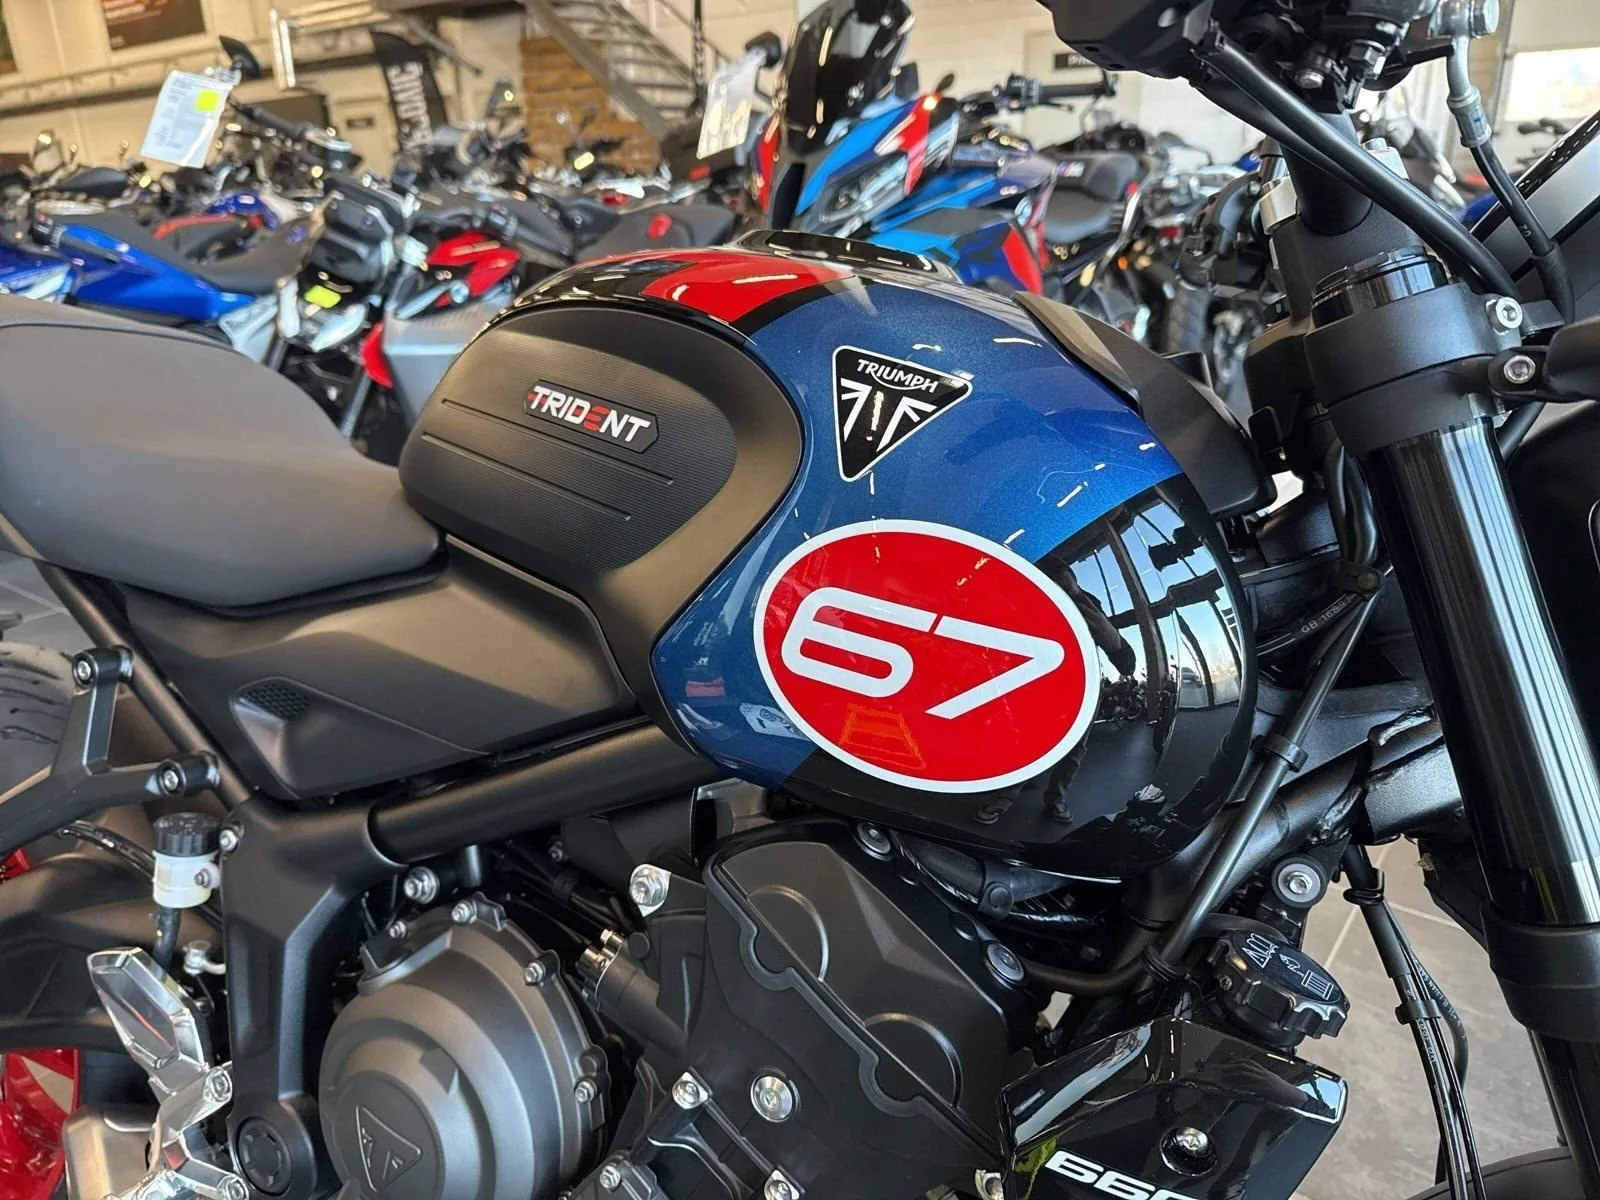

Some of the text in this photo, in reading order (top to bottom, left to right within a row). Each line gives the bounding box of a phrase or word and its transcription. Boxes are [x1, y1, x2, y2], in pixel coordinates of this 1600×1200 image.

[857, 358, 939, 393] TRIUMPH
[529, 385, 651, 442] TRIDENT
[1301, 620, 1318, 633] GB
[781, 586, 1065, 720] 67
